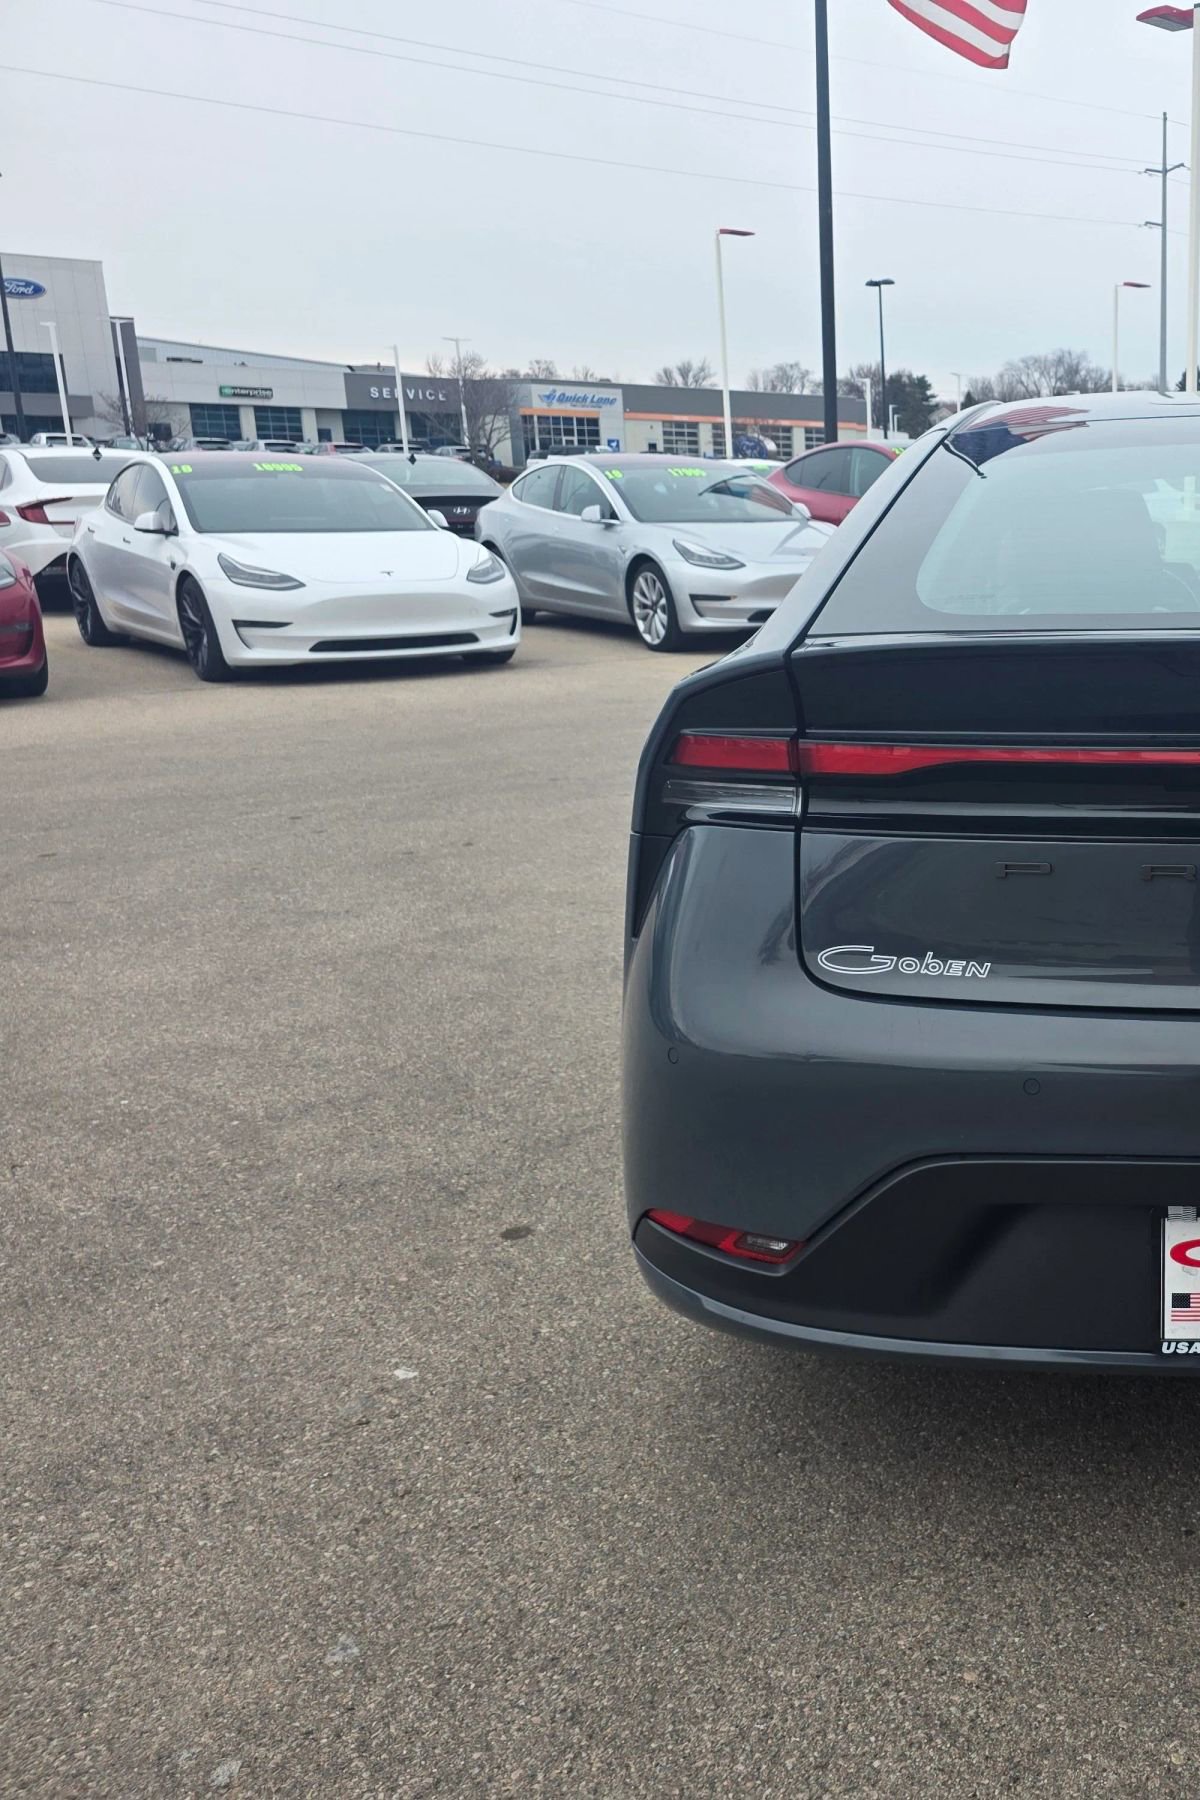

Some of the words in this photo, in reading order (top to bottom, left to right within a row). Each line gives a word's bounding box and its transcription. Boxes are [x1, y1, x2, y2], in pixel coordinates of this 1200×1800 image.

[4, 280, 34, 294] Ford
[557, 392, 589, 404] Quick
[590, 395, 617, 406] Lane
